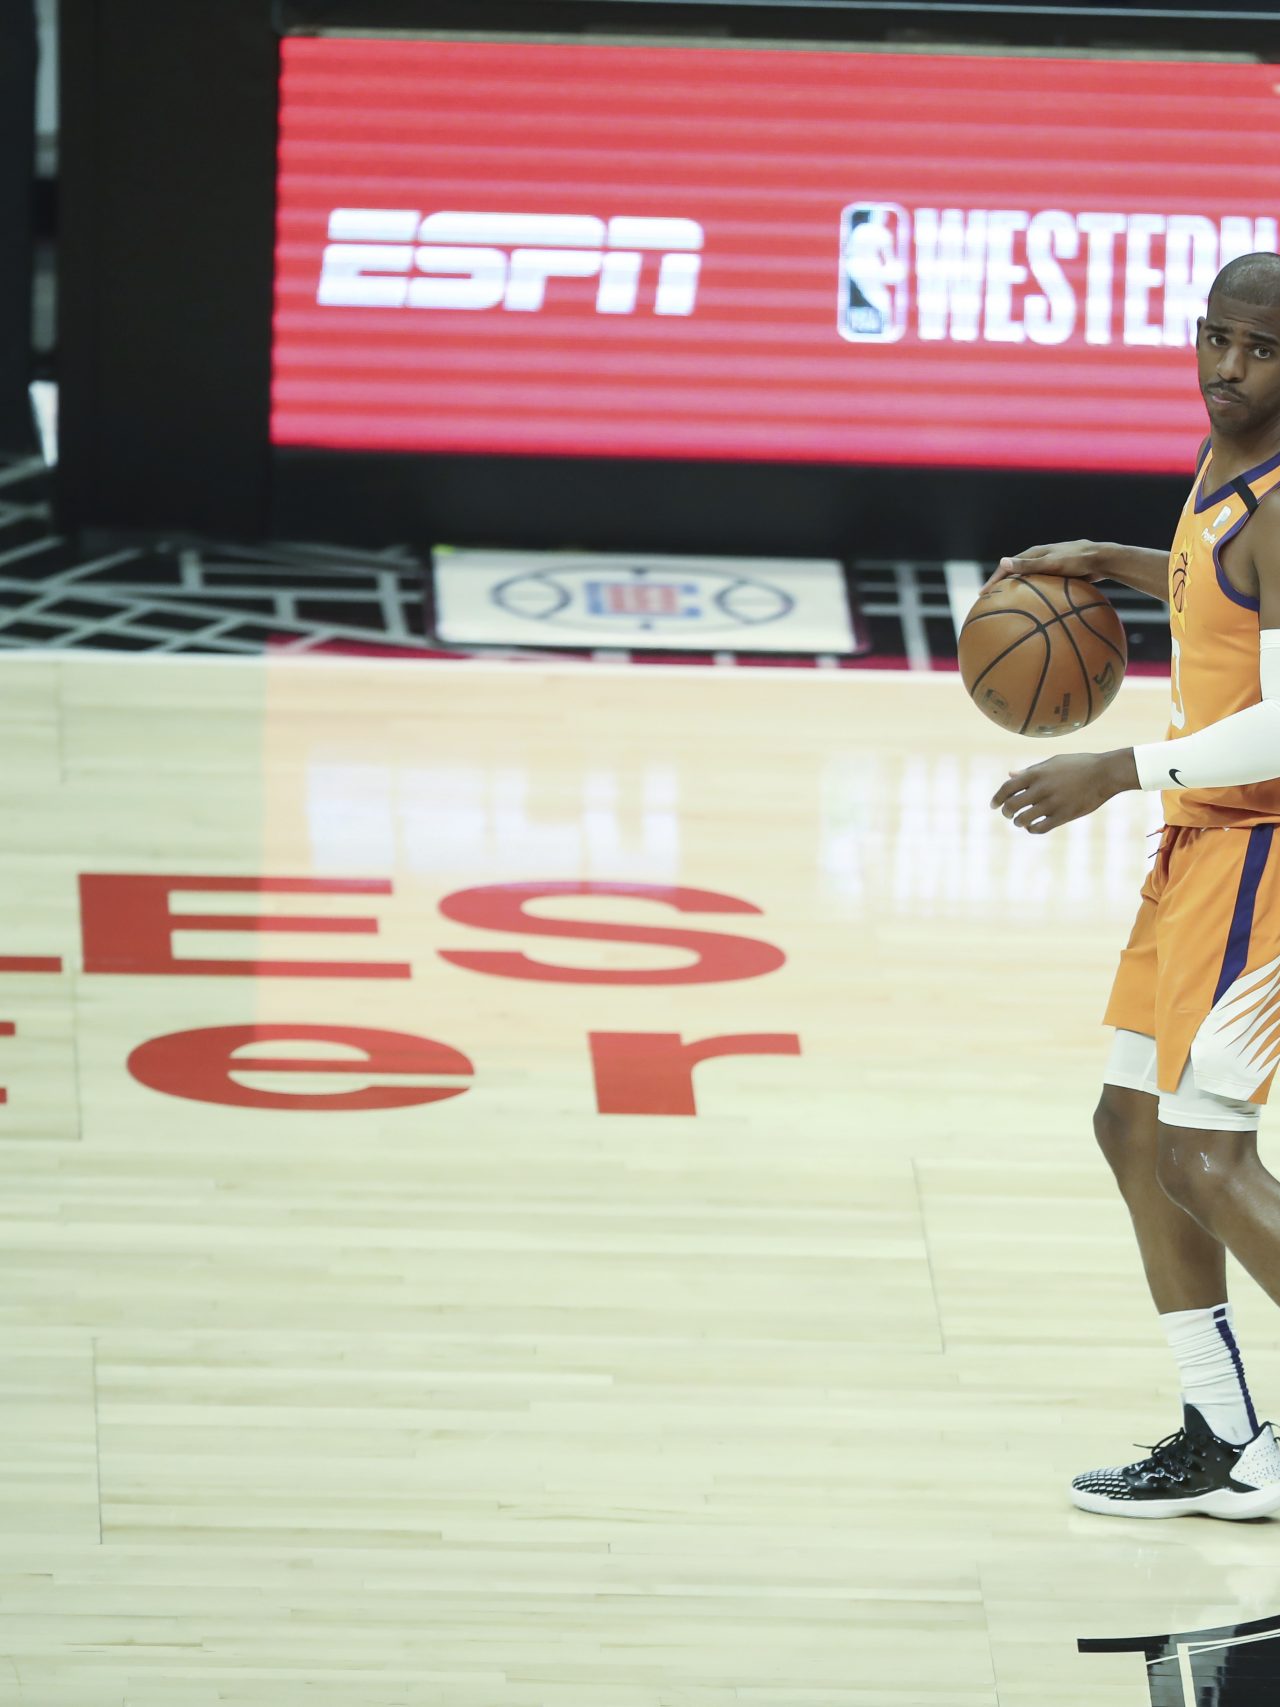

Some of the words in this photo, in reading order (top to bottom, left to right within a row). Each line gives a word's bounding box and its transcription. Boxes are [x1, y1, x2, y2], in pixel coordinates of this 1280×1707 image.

[316, 207, 704, 316] ESPN
[0, 873, 787, 986] ES
[0, 1022, 802, 1118] er
